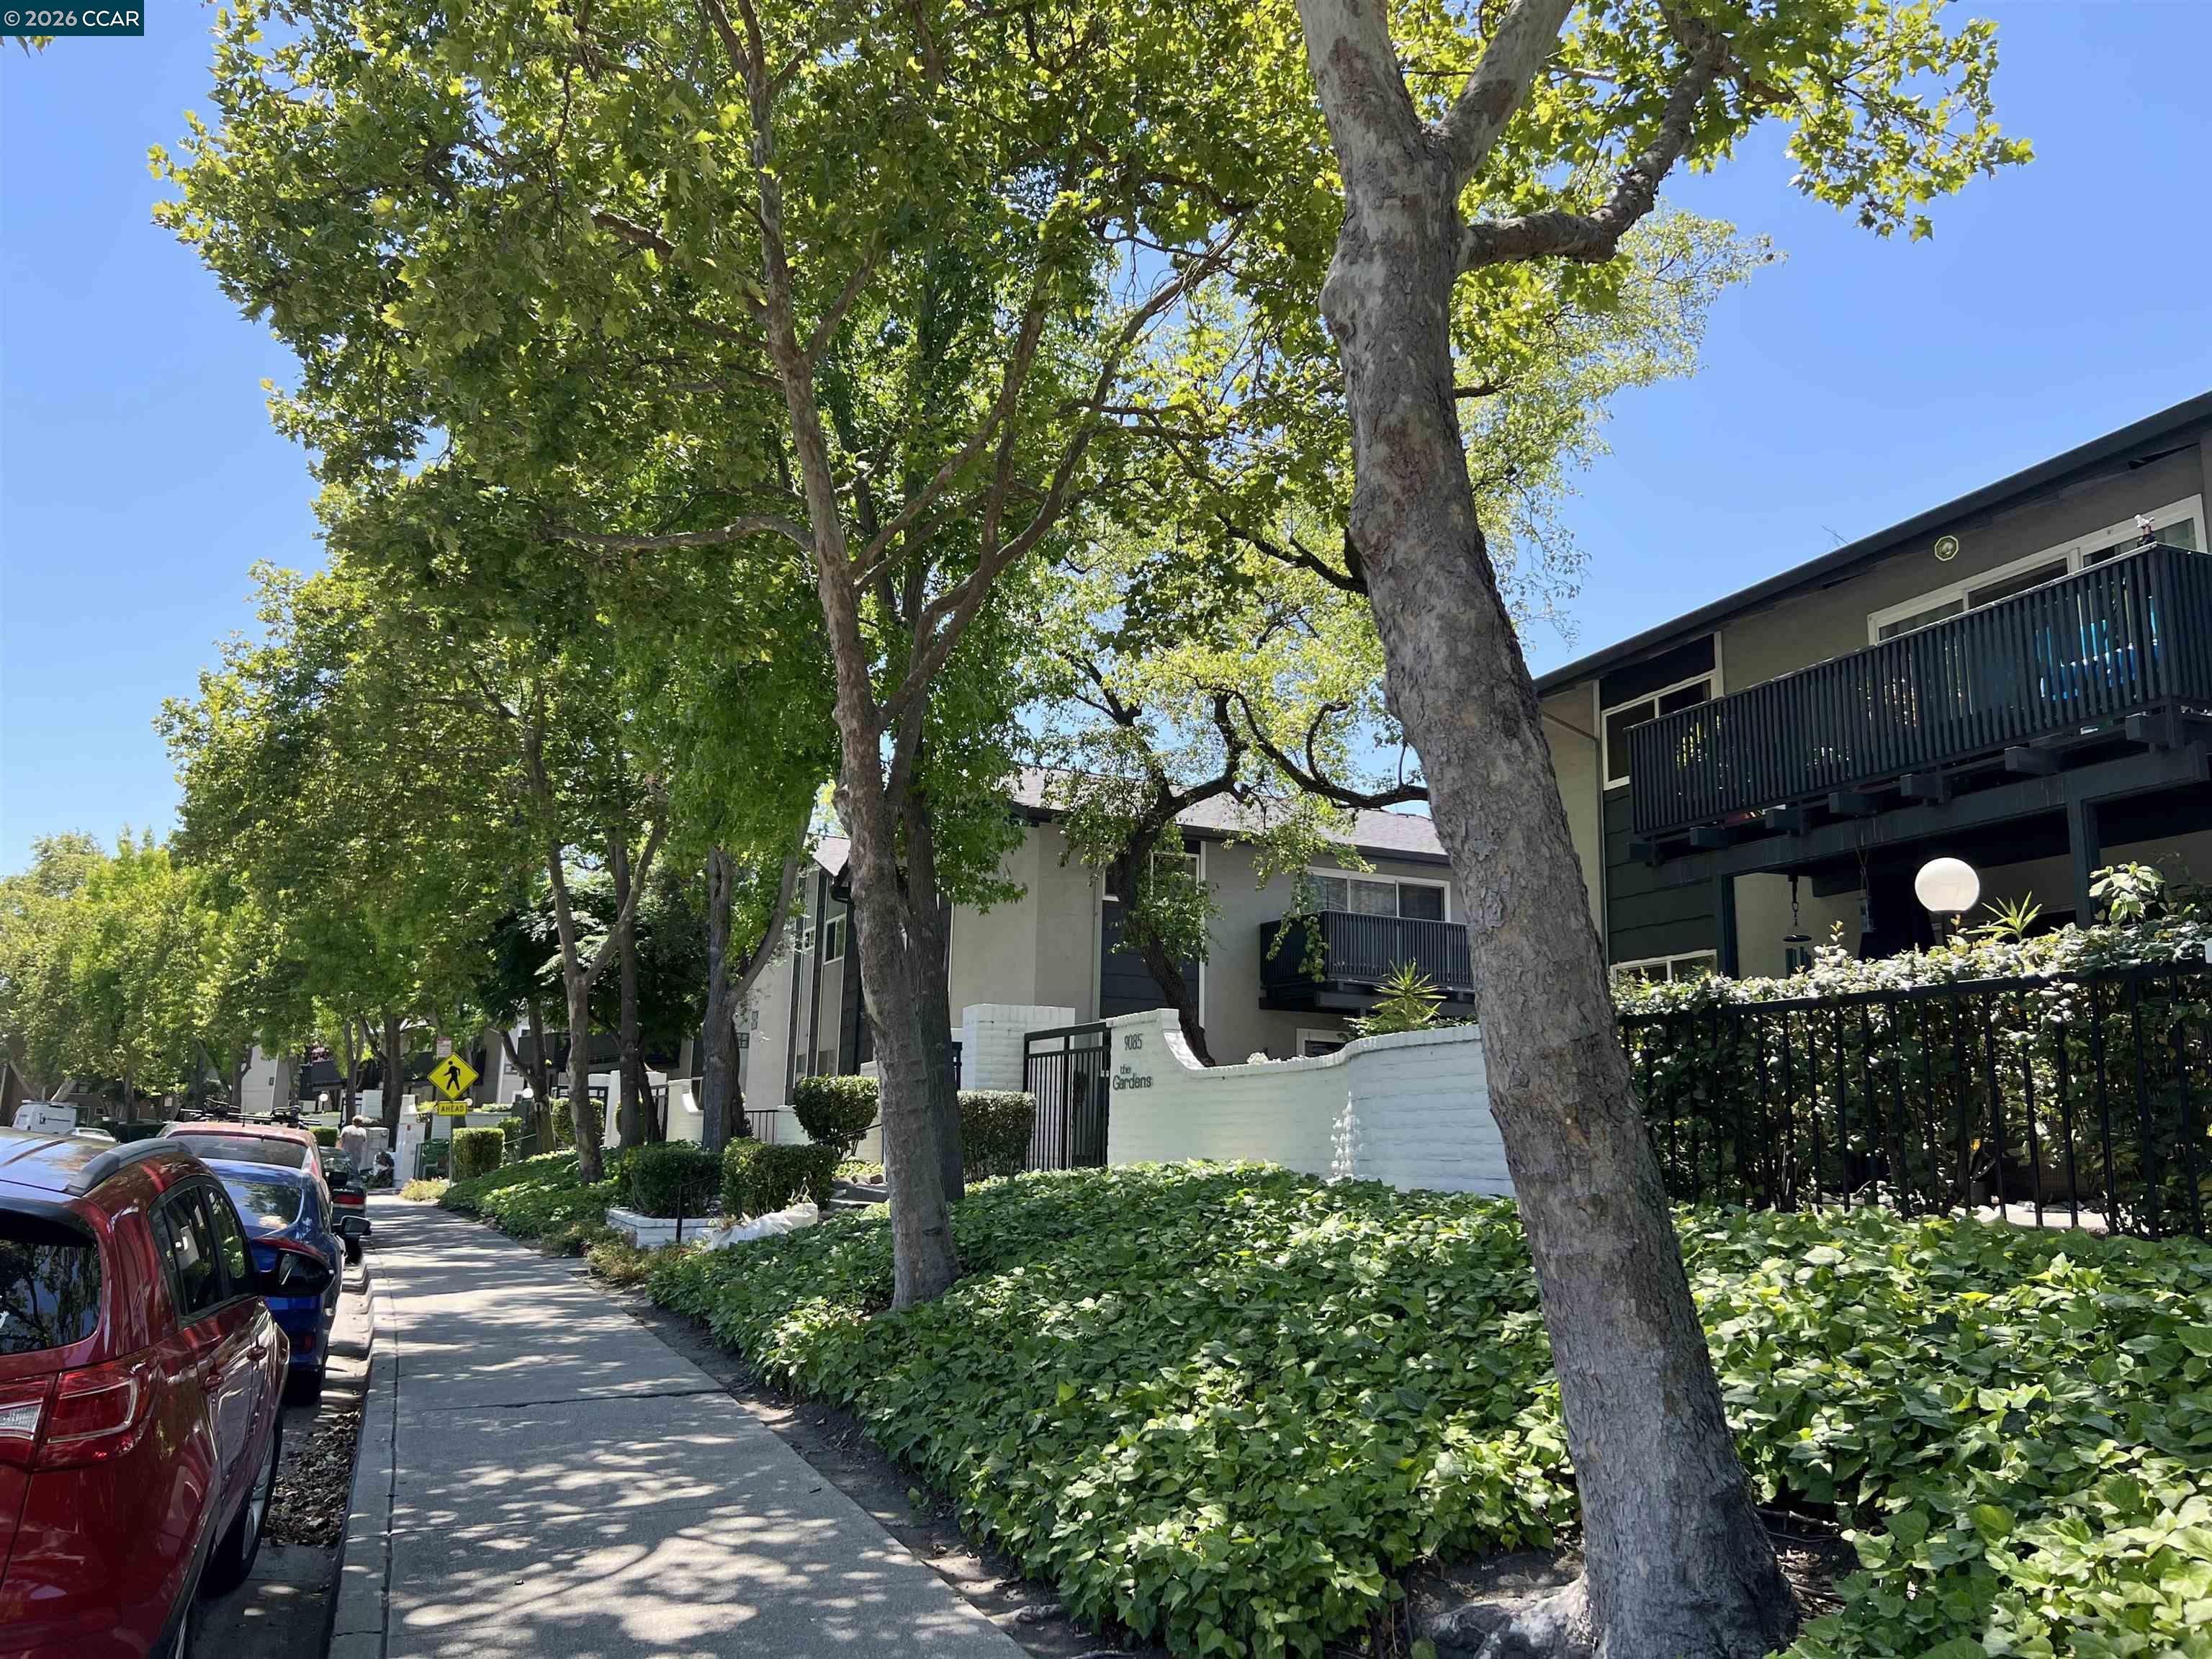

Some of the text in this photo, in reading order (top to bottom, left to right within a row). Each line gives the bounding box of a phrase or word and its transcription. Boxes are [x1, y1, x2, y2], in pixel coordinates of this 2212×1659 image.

[1124, 1033, 1143, 1051] 9085
[1120, 1064, 1131, 1074] the
[1112, 1072, 1152, 1090] Gardens
